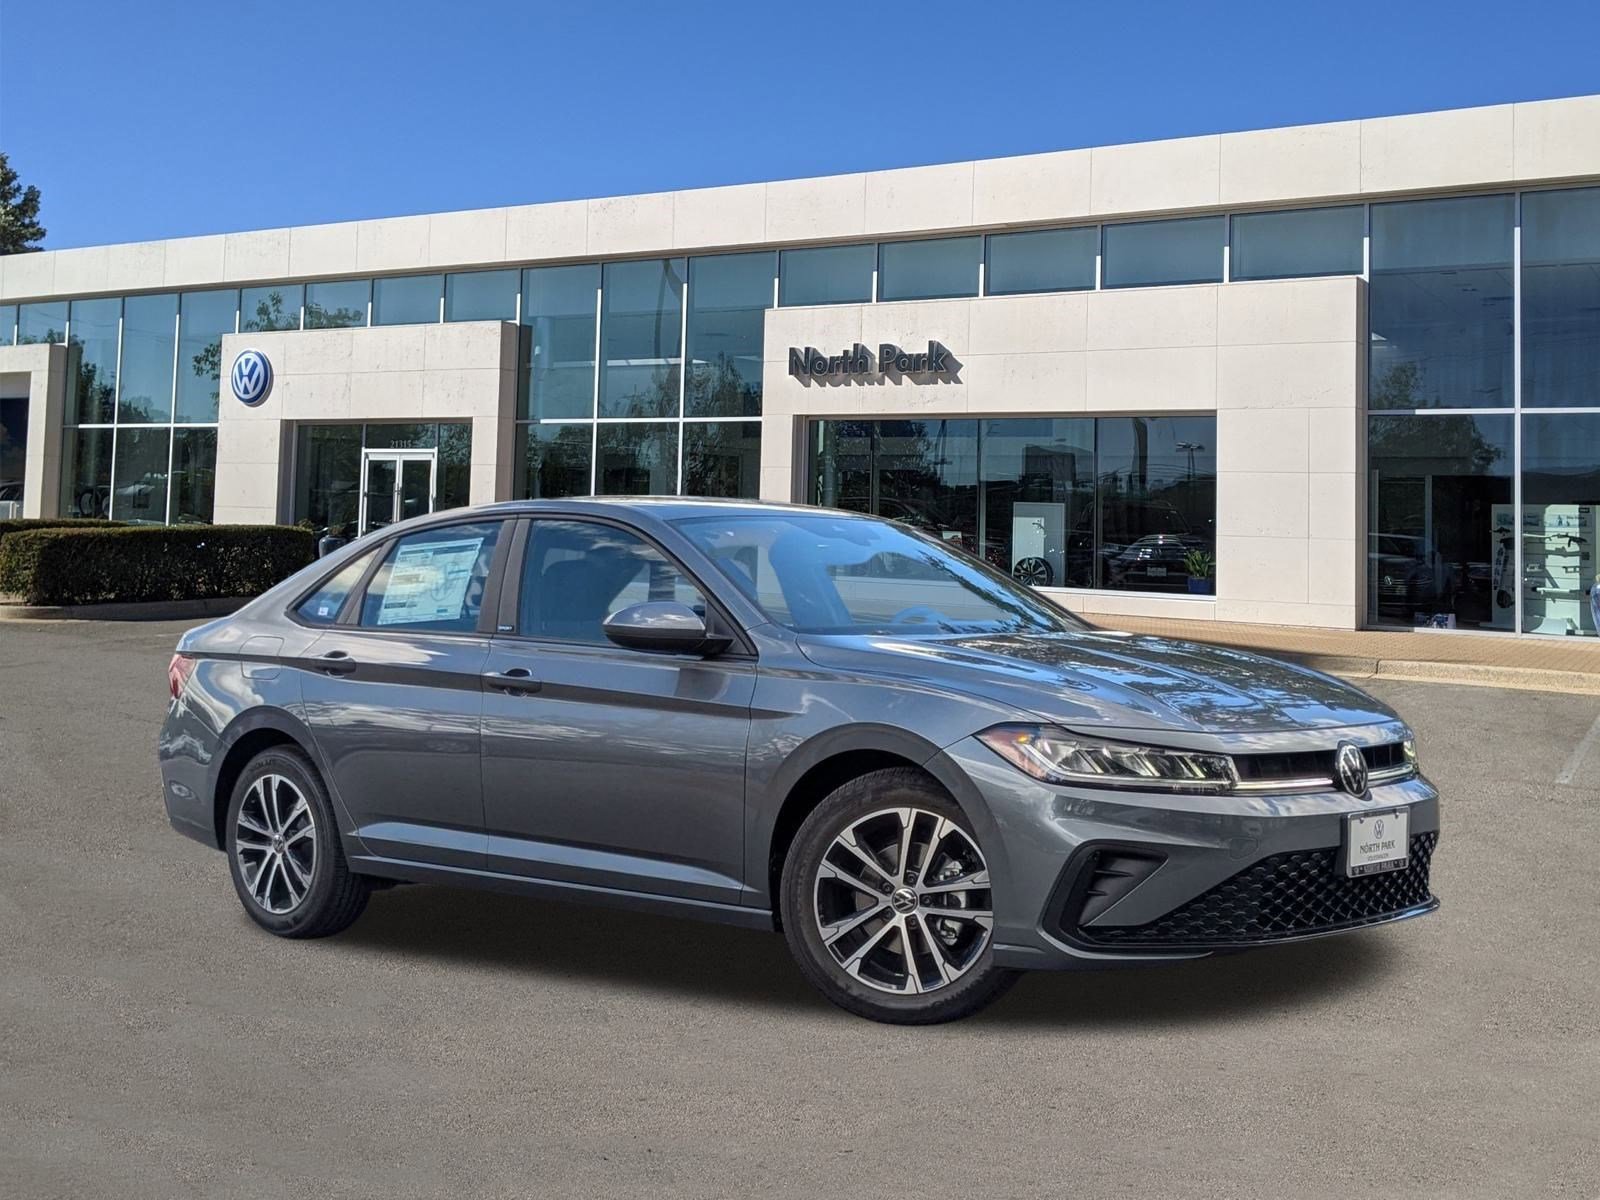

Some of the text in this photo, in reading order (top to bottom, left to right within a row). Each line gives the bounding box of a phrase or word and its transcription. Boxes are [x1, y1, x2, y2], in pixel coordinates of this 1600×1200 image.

[788, 340, 946, 376] North Park
[1360, 842, 1381, 854] NORTH
